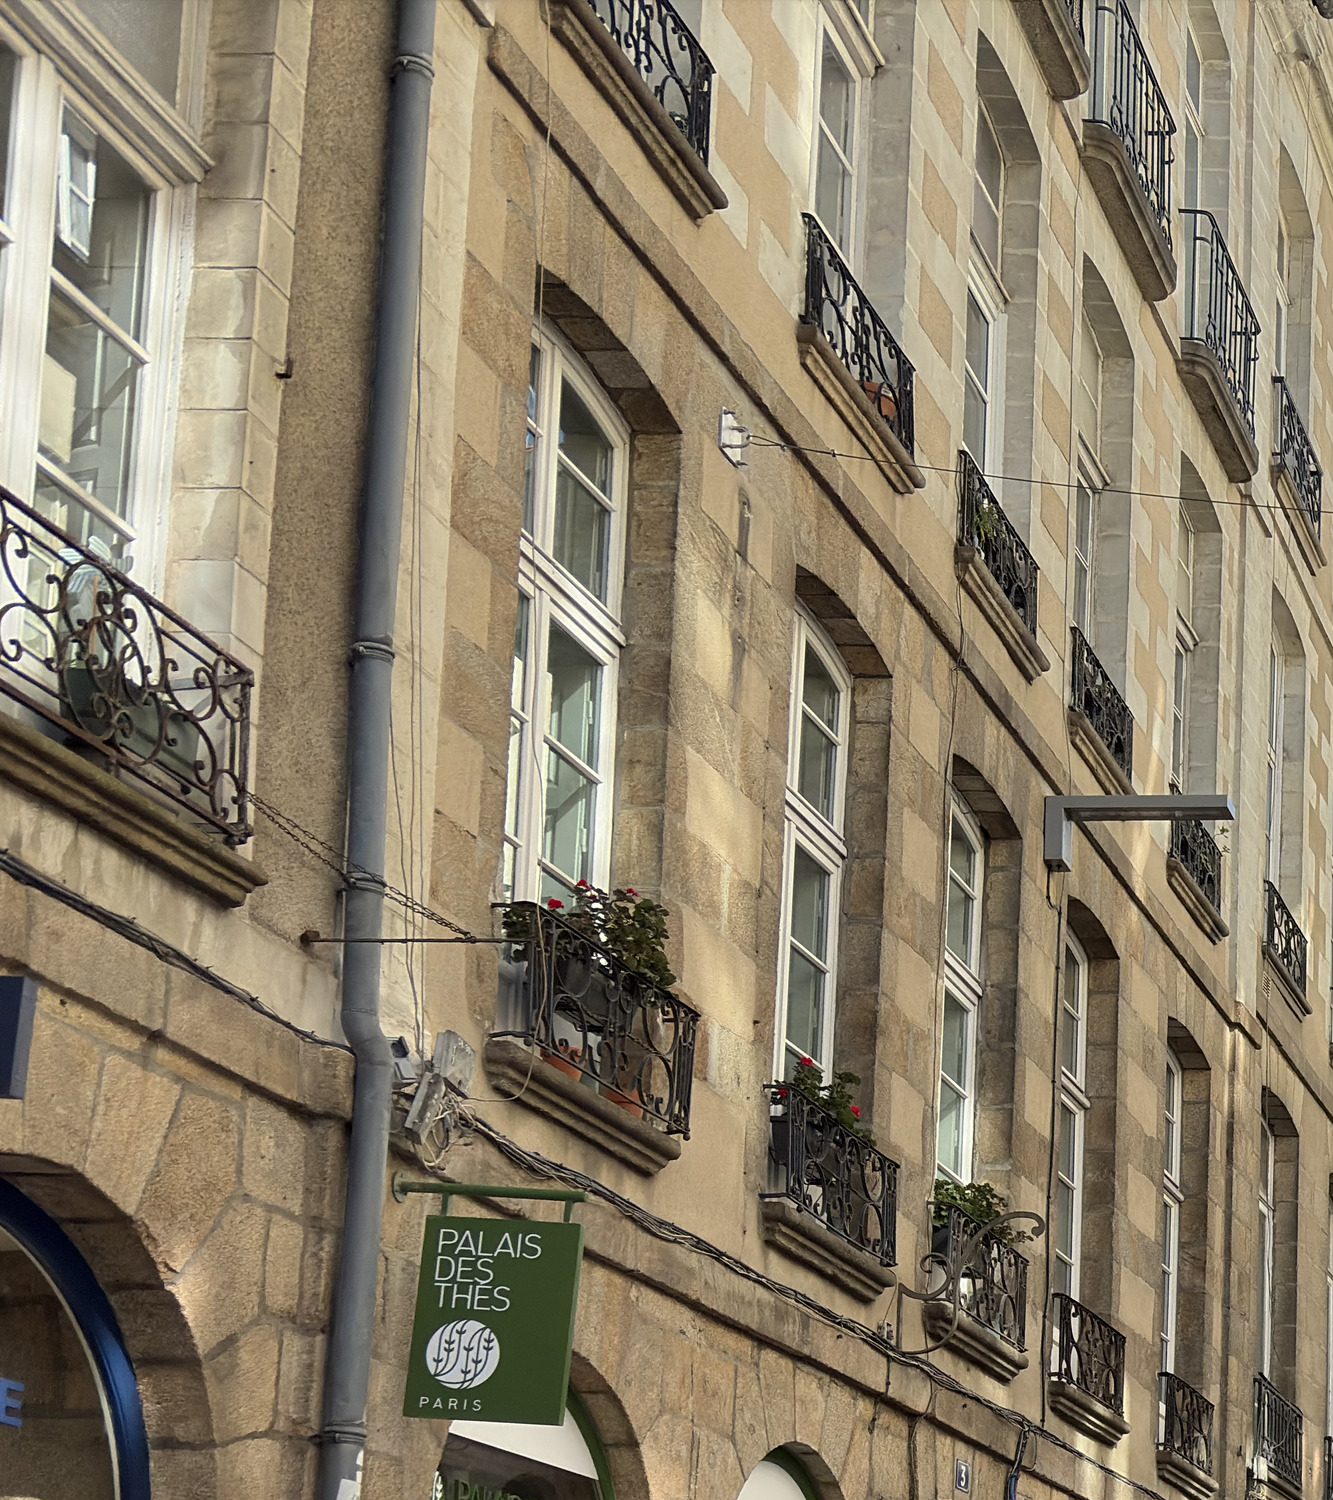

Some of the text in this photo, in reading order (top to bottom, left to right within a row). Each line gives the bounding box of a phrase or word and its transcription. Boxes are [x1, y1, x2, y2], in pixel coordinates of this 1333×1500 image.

[437, 1228, 542, 1260] PALAIS
[434, 1255, 494, 1284] DES
[434, 1281, 511, 1312] THÉS
[419, 1396, 482, 1411] PARIS
